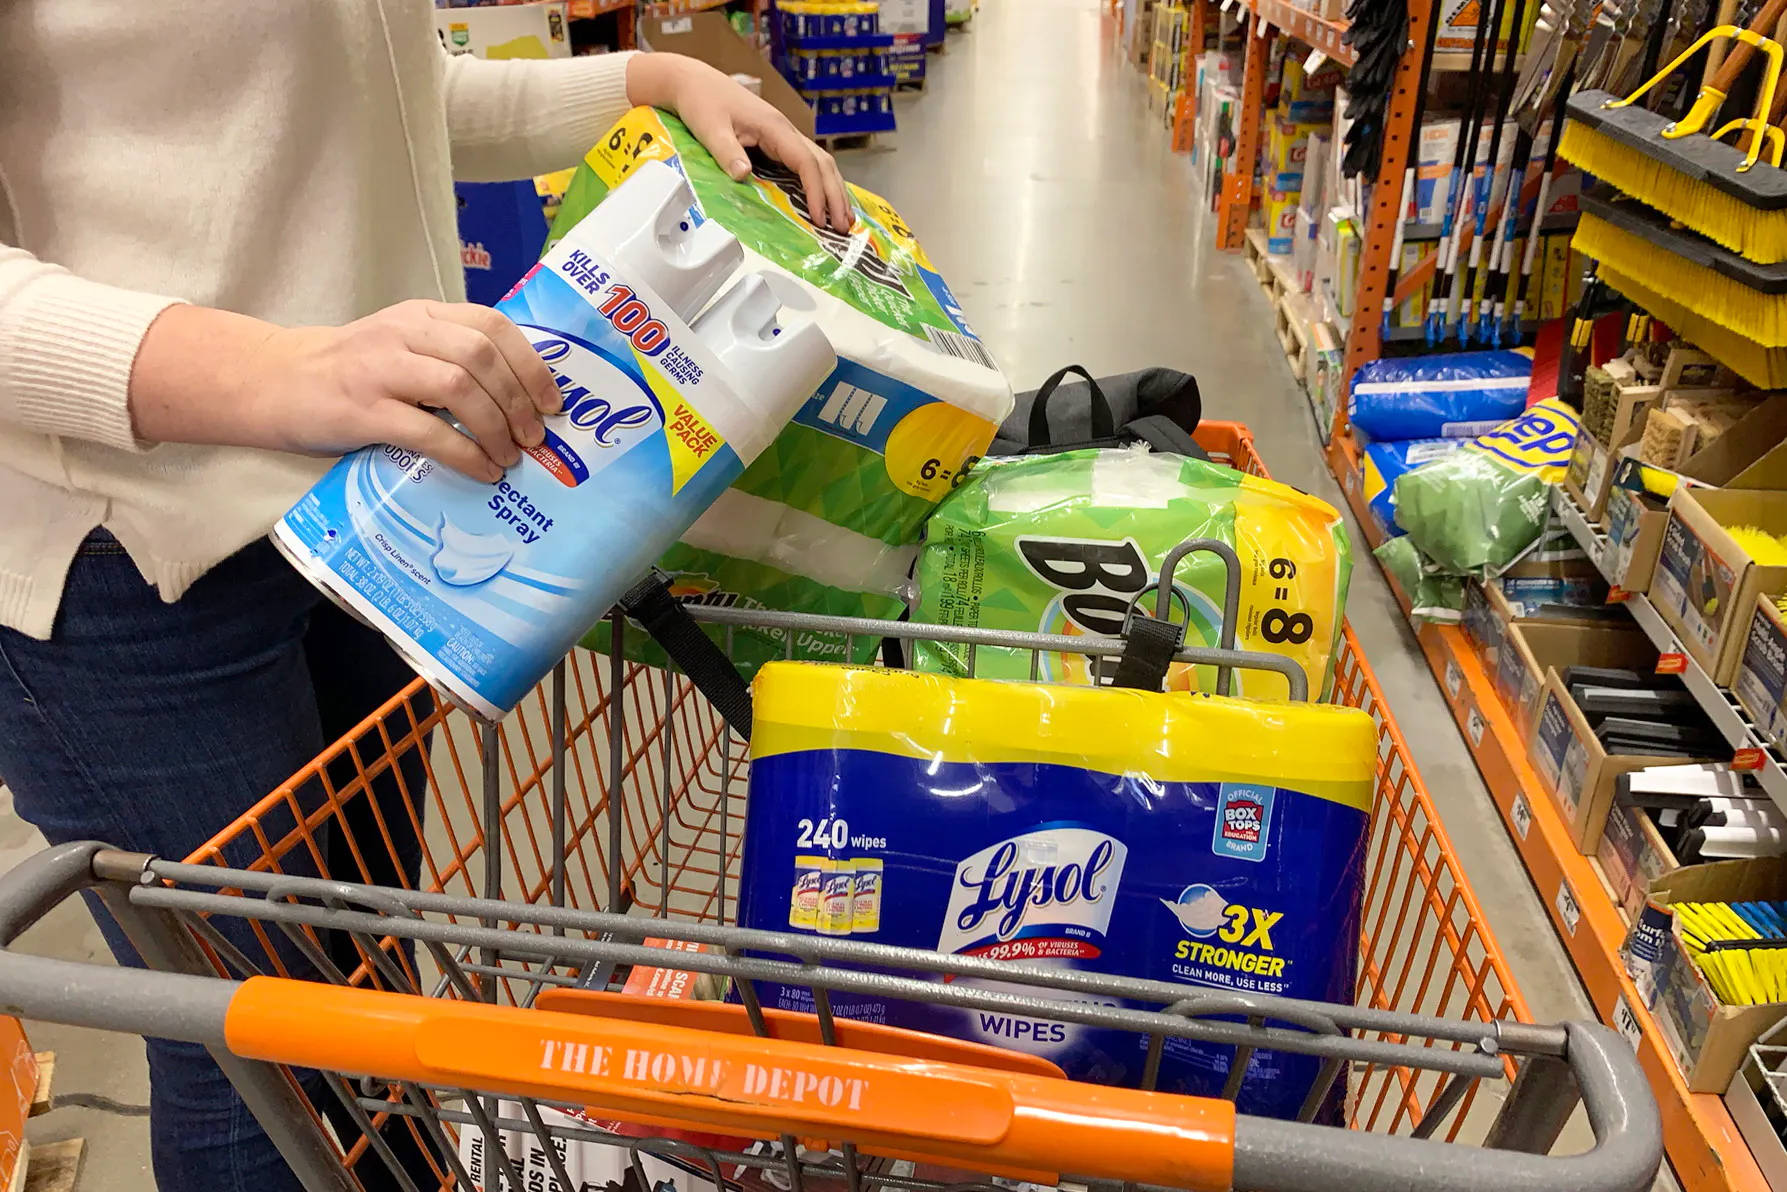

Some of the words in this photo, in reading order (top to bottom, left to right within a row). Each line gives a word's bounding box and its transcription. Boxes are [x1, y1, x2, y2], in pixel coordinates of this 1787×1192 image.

[609, 128, 626, 150] 6
[562, 261, 600, 295] OVER
[570, 249, 610, 284] KILLS
[597, 284, 671, 356] 100
[660, 359, 688, 385] GERMS
[666, 352, 700, 385] CAUSING
[672, 345, 704, 377] ILLNESS
[670, 421, 710, 458] PACK
[673, 404, 718, 448] VALUE
[920, 458, 941, 480] 6
[487, 494, 541, 545] Spray
[375, 533, 392, 557] Crisp
[410, 564, 432, 585] scent
[1268, 558, 1297, 581] 6
[1260, 608, 1313, 645] 8
[1227, 789, 1264, 804] OFFICIAL
[1224, 807, 1257, 820] BOX
[1228, 820, 1261, 831] TOPS
[796, 818, 849, 850] 240
[851, 835, 887, 849] wipes
[1224, 831, 1257, 841] EDUCATION
[1226, 840, 1253, 852] BRAND
[1218, 904, 1284, 950] 3X
[1172, 964, 1203, 979] CLEAN
[1205, 968, 1233, 986] MORE,
[1236, 974, 1254, 989] USE
[780, 987, 785, 996] 3
[791, 988, 800, 999] 80
[980, 1013, 1065, 1042] WIPES
[539, 1038, 613, 1076] THE
[623, 1049, 730, 1088] HOME
[744, 1063, 870, 1111] DEPOT
[471, 1137, 483, 1183] RENTAL
[530, 1147, 546, 1168] IN
